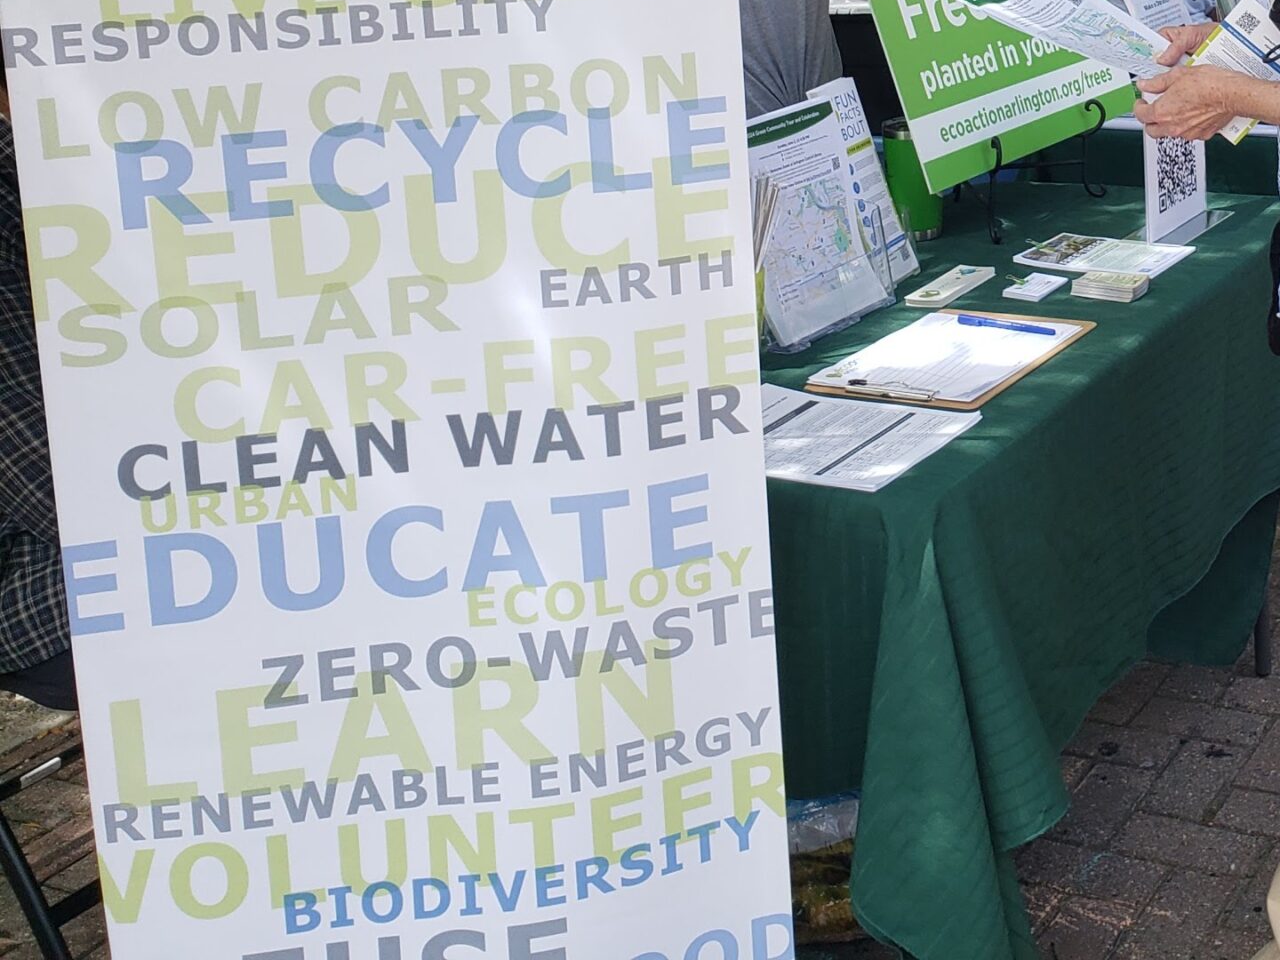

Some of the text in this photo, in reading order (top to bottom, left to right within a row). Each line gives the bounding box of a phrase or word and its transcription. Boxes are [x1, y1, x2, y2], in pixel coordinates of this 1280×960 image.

[37, 52, 700, 161] LOW CARBON
[835, 90, 857, 111] FUN
[840, 106, 861, 124] FACTS
[920, 36, 1059, 99] planted in you
[939, 67, 1113, 144] ecoactionarlington.org/trees
[113, 96, 731, 231] RECYCLE
[841, 120, 866, 142] BOUT
[22, 150, 735, 323] REDUCE
[540, 249, 733, 310] EARTH
[56, 276, 461, 368] SOLAR
[172, 313, 757, 444] CAR-FREE
[117, 420, 408, 502] CLEAN
[446, 385, 750, 469] WATER
[62, 472, 714, 637] EDUCATE
[140, 473, 359, 534] URBAN
[466, 547, 753, 628] ECOLOGY
[261, 587, 775, 709] ZERO-WASTE
[102, 707, 774, 844] RENEWABLE ENERGY
[108, 637, 677, 811] LEARN
[97, 751, 786, 925] VOLUNTEER
[282, 810, 762, 935] BIODIVERSITY
